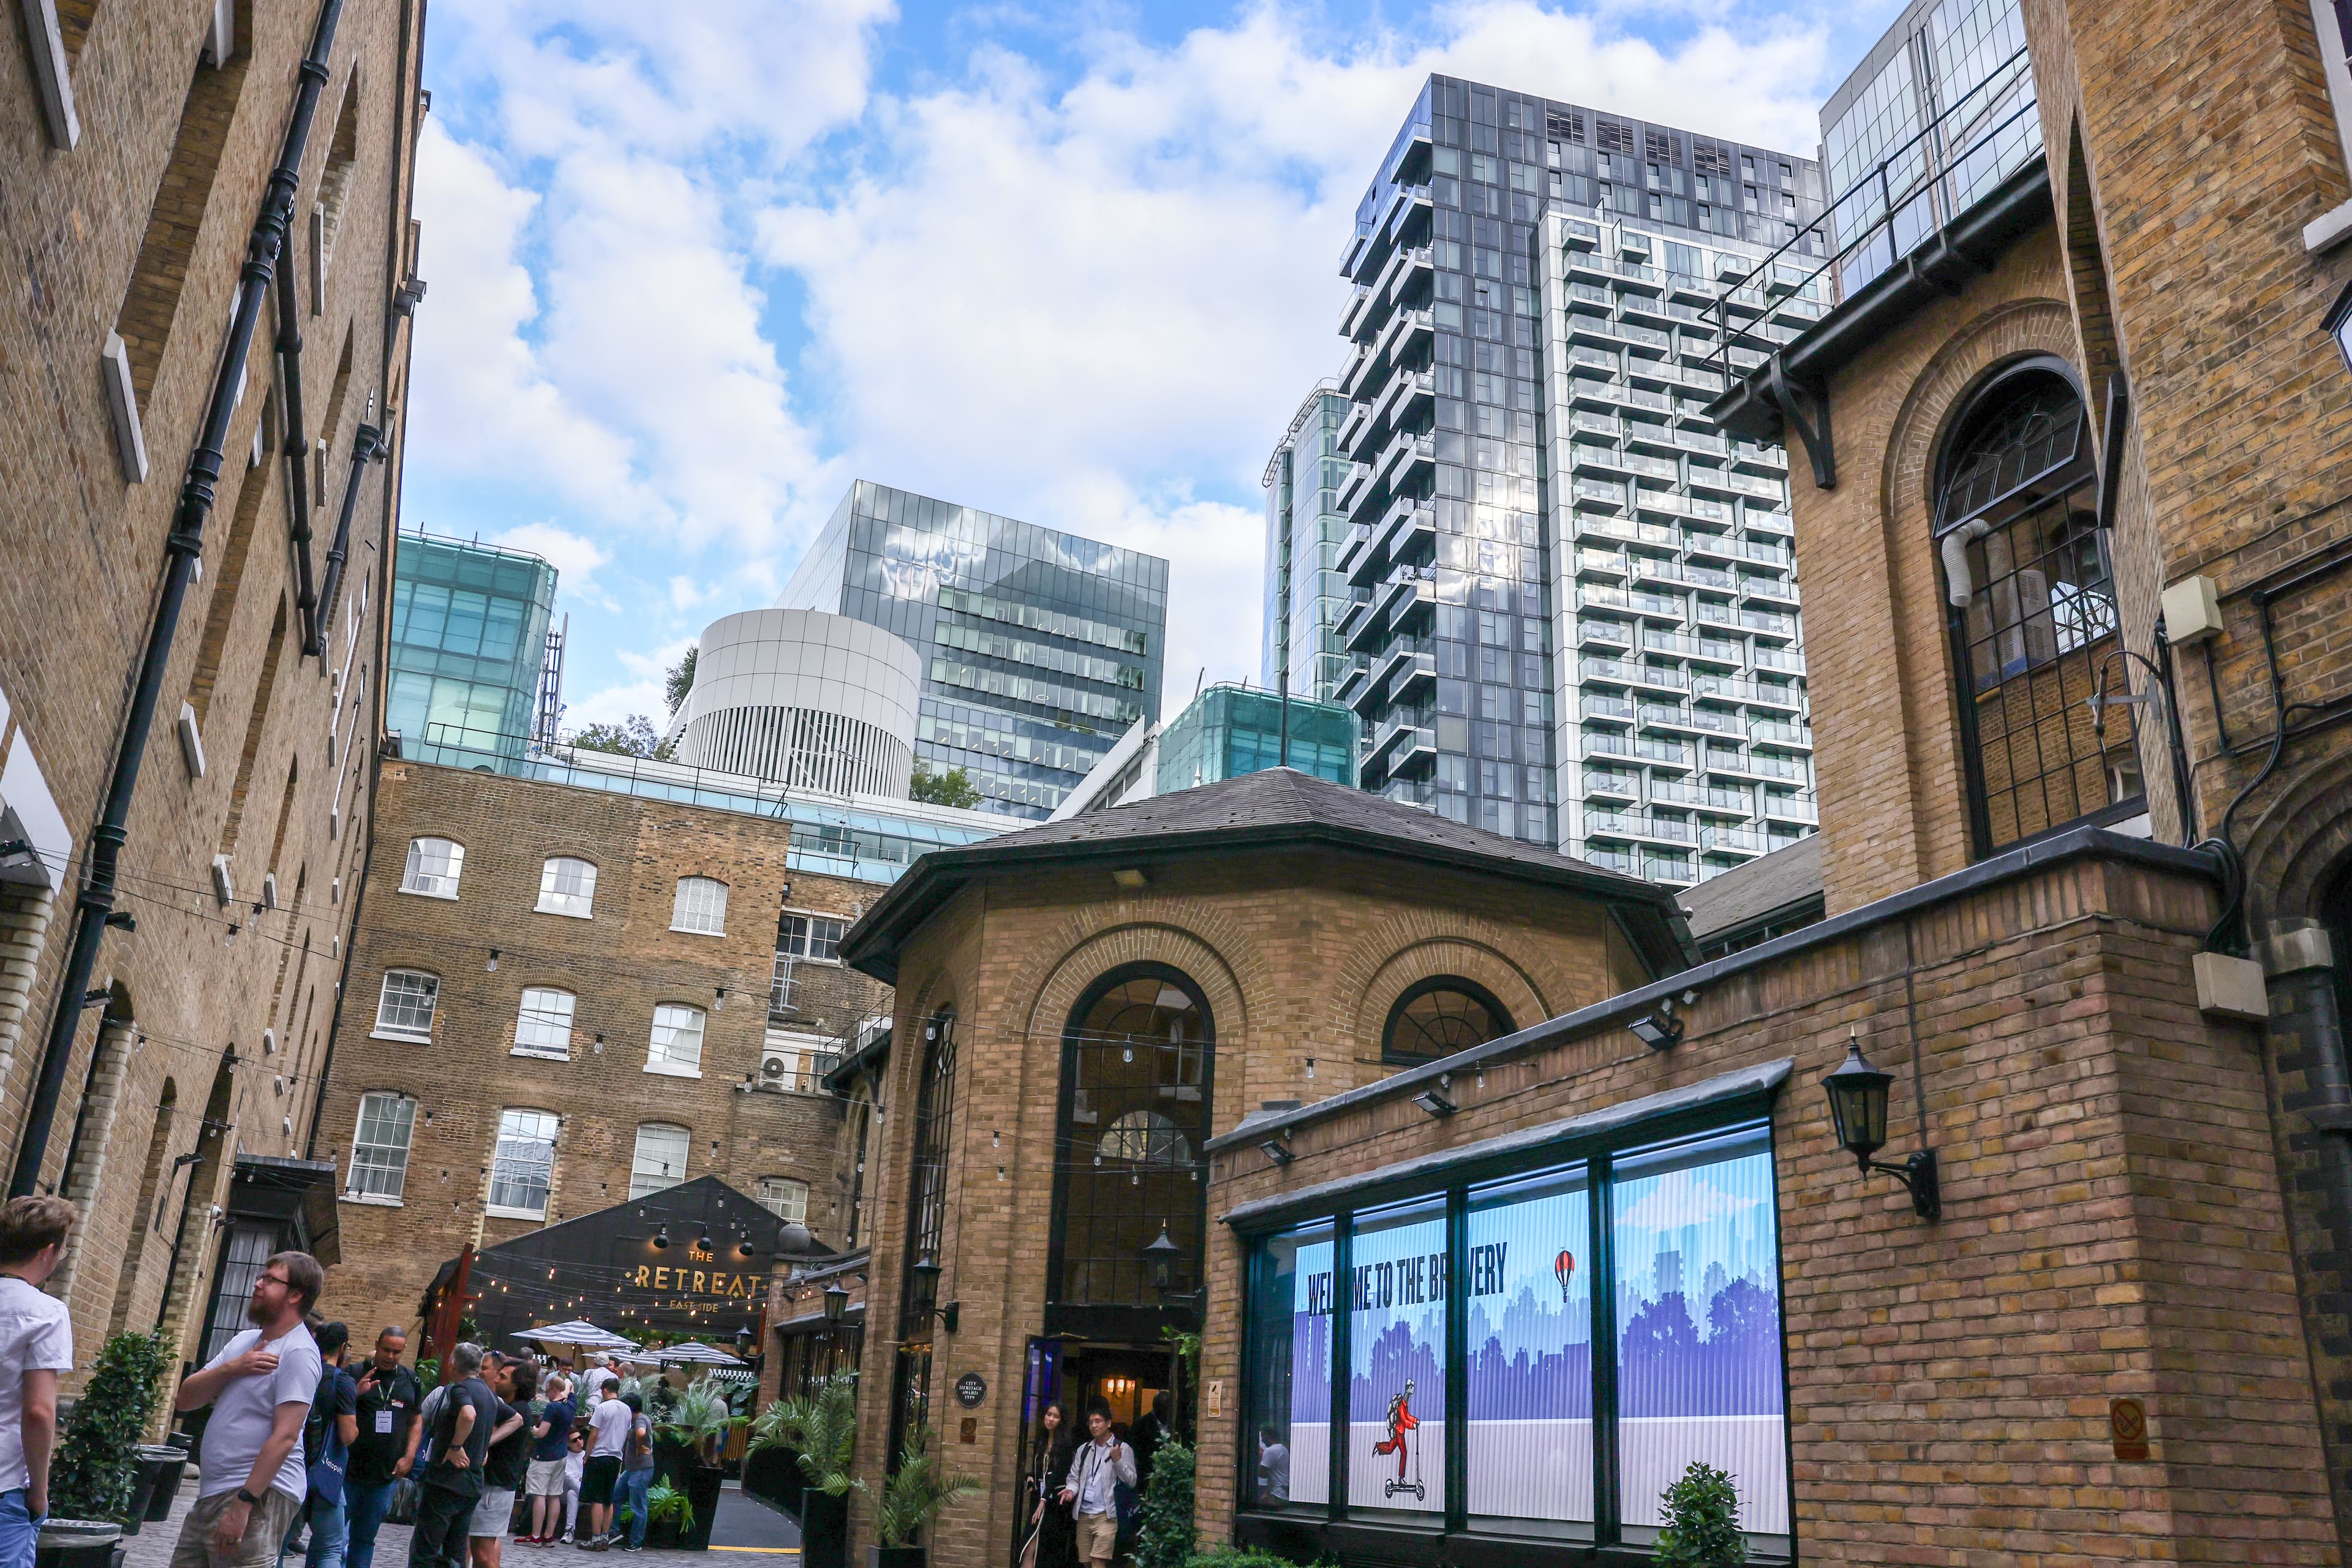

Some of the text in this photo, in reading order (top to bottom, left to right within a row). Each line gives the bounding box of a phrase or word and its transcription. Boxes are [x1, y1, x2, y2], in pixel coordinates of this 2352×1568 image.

[689, 1251, 714, 1262] THE
[636, 1265, 761, 1297] RETREAT
[1375, 1261, 1393, 1309] TO
[1397, 1256, 1425, 1306] THE
[670, 1300, 718, 1313] EAST SIDE
